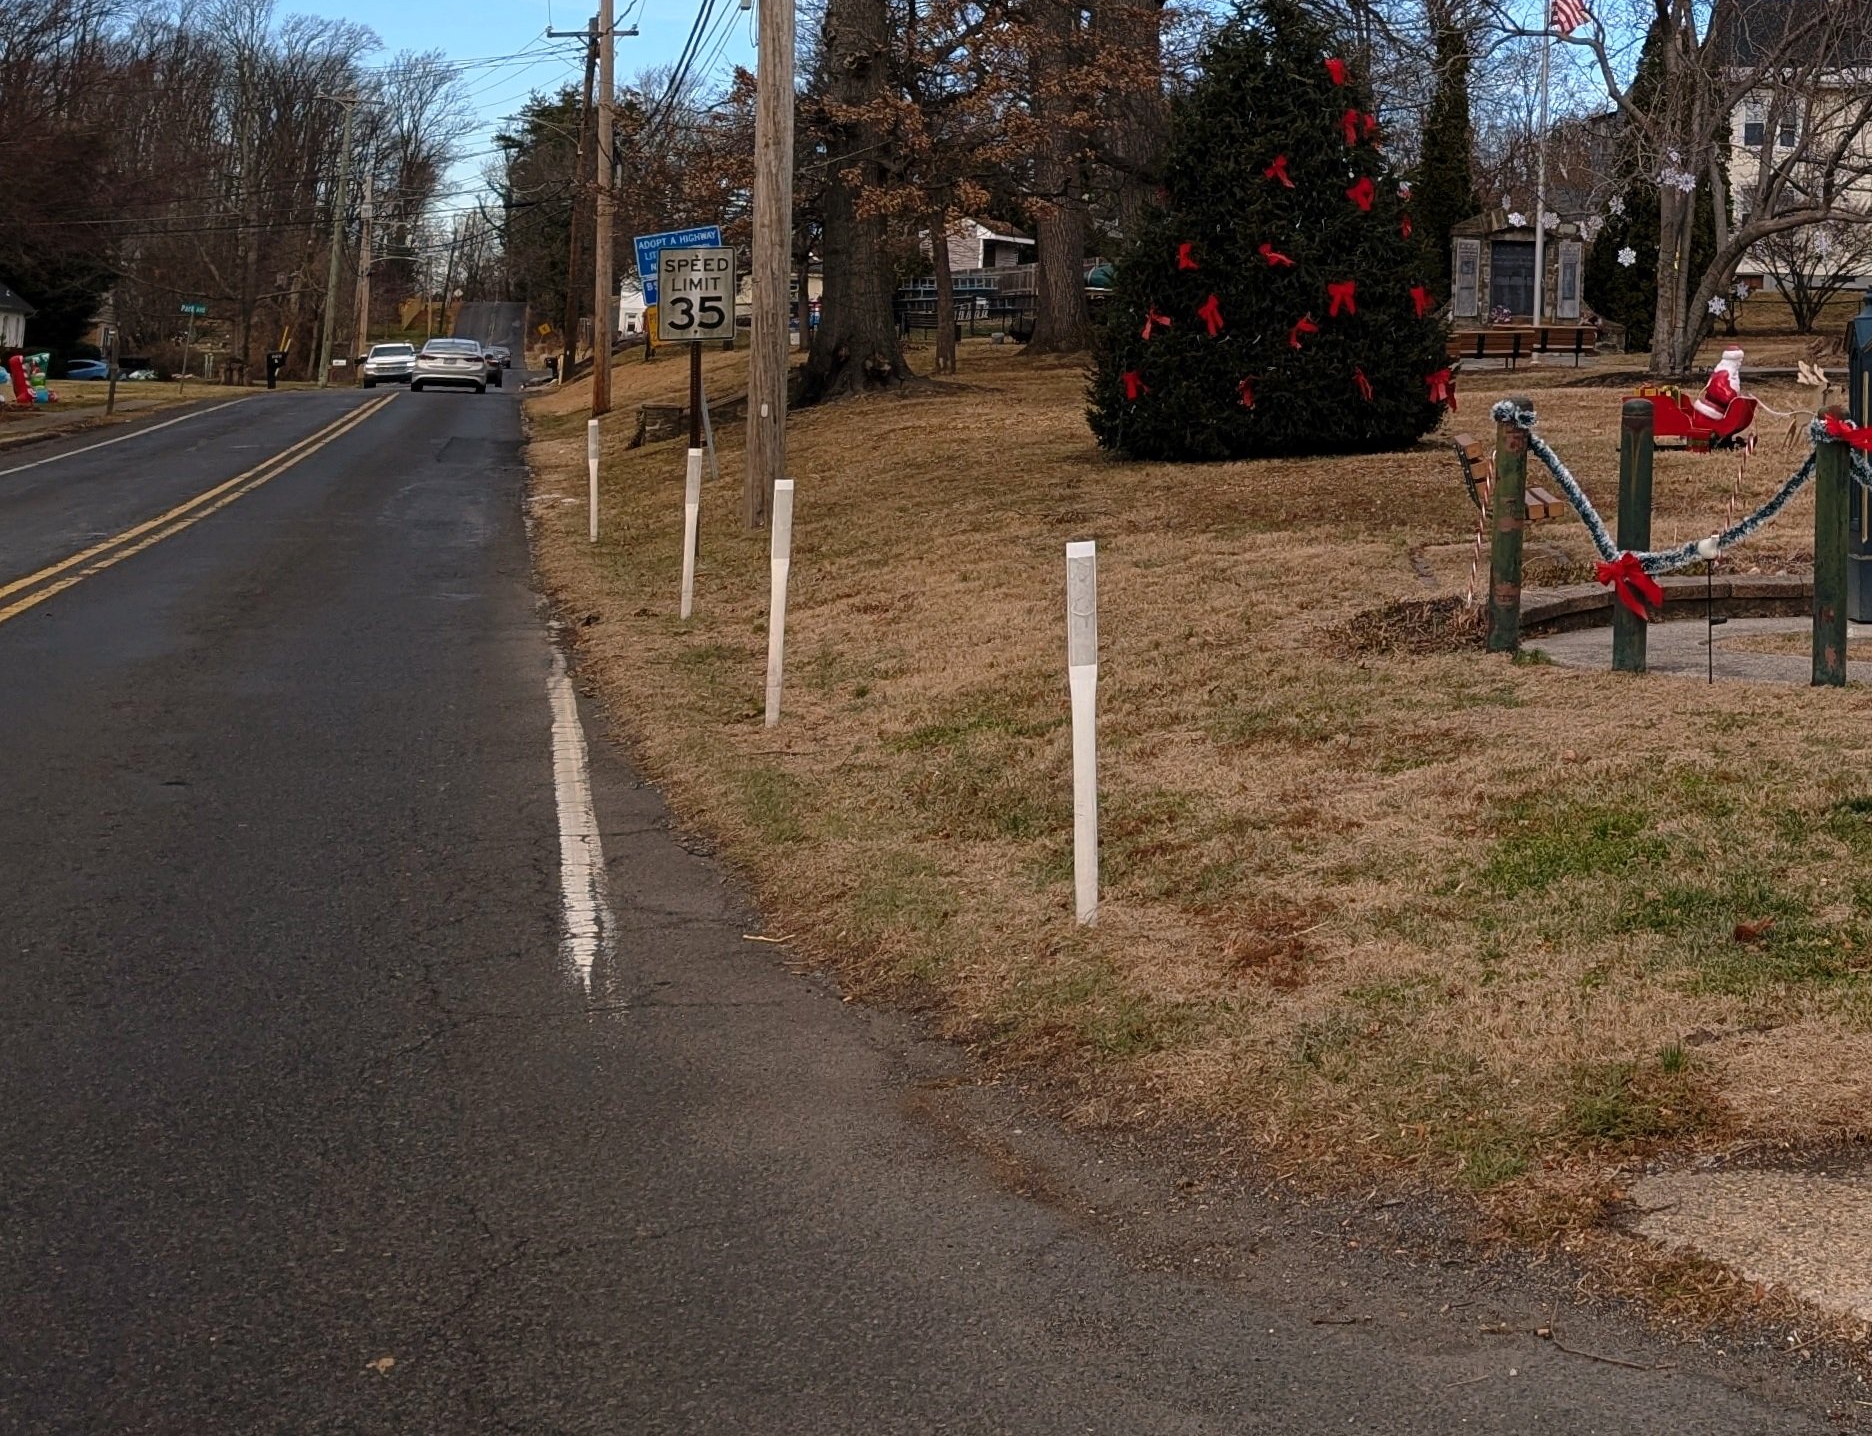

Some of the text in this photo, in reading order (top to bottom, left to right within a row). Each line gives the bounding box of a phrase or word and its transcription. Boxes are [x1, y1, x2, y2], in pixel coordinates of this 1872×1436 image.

[638, 231, 716, 249] ADOPT A HIGHWAY
[664, 257, 729, 272] SPEED
[671, 277, 721, 292] LIMIT
[181, 304, 194, 313] Park
[668, 295, 726, 331] 35
